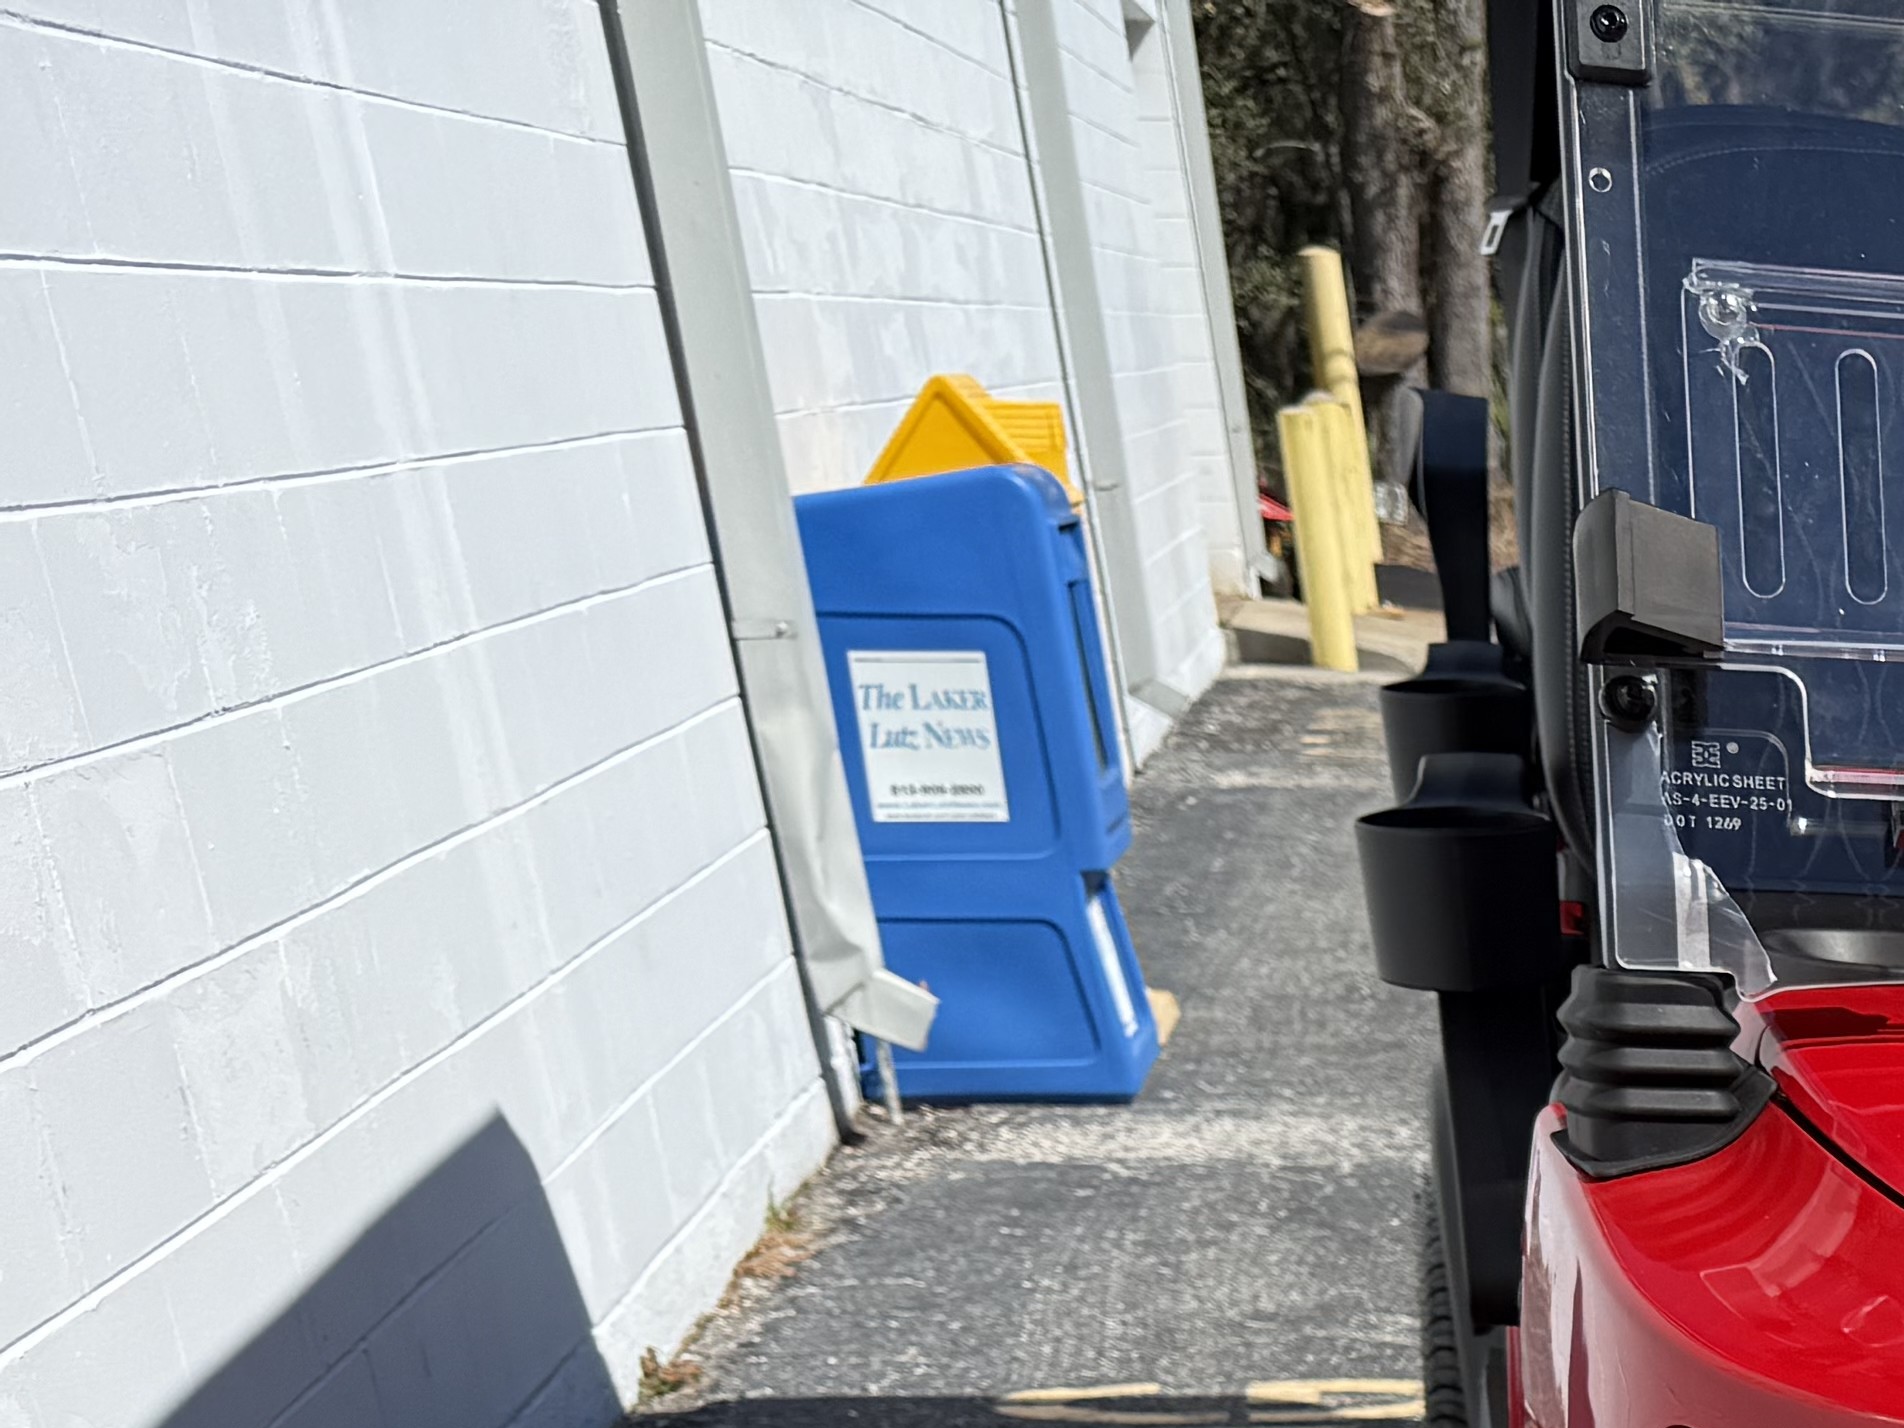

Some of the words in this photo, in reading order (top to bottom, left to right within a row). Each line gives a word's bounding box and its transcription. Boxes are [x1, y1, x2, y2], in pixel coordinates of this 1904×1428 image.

[859, 683, 904, 711] The
[870, 722, 921, 751] Lutz
[1661, 770, 1730, 788] ACRYLIC
[1732, 775, 1786, 791] SHEET
[1706, 816, 1742, 830] 1269
